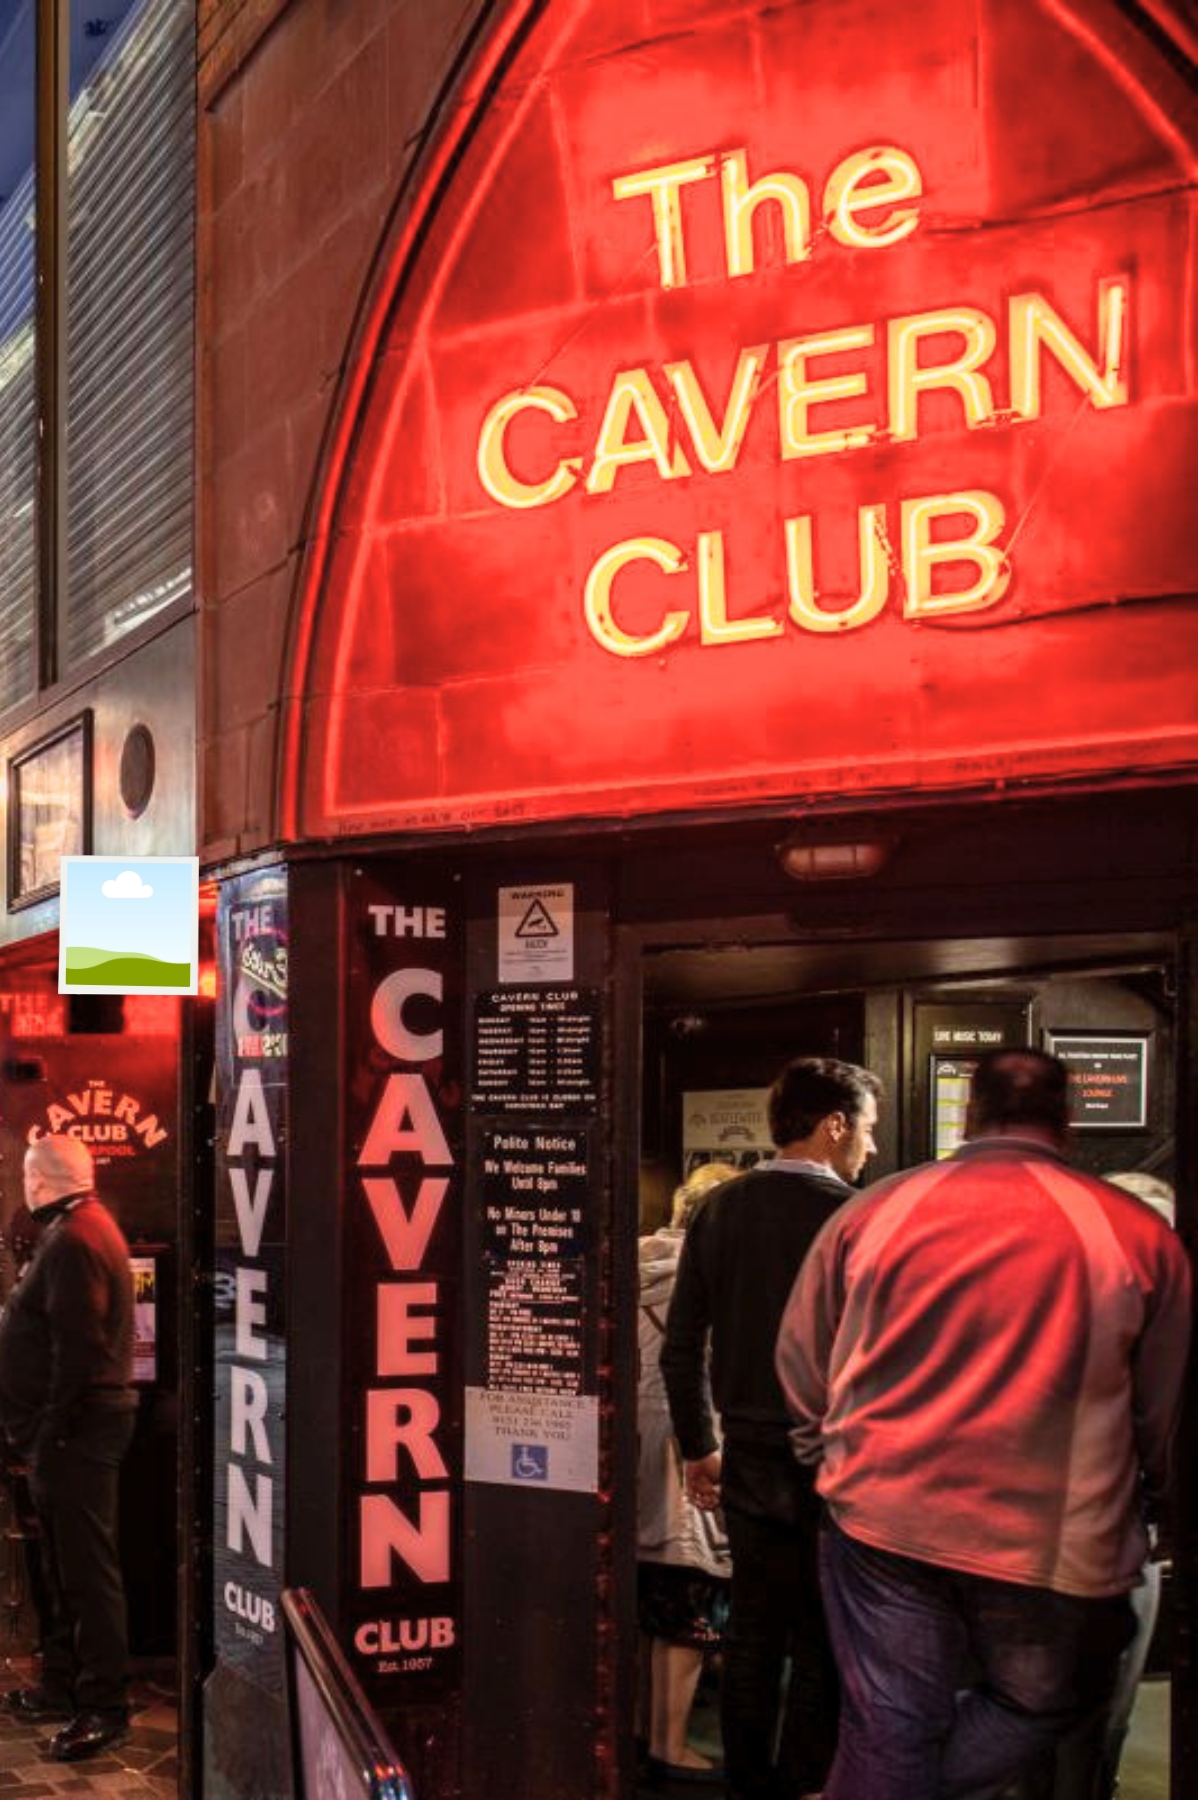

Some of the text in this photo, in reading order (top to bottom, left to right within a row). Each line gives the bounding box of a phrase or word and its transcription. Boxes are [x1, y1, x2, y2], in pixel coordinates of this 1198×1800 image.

[612, 145, 922, 291] The
[476, 273, 1130, 508] CAVERN
[583, 490, 1012, 658] CLUB
[231, 904, 274, 940] THE
[368, 904, 446, 938] THE
[492, 991, 578, 1003] CAVERN CLUB
[67, 1125, 127, 1141] CLUB
[494, 1136, 576, 1151] Polite Notice
[487, 1206, 501, 1220] No
[505, 1206, 536, 1220] Minors
[540, 1208, 567, 1221] Under
[512, 1222, 528, 1237] The
[357, 967, 454, 1588] CAVERN
[224, 1581, 275, 1633] CLUB
[354, 1617, 455, 1656] CLUB
